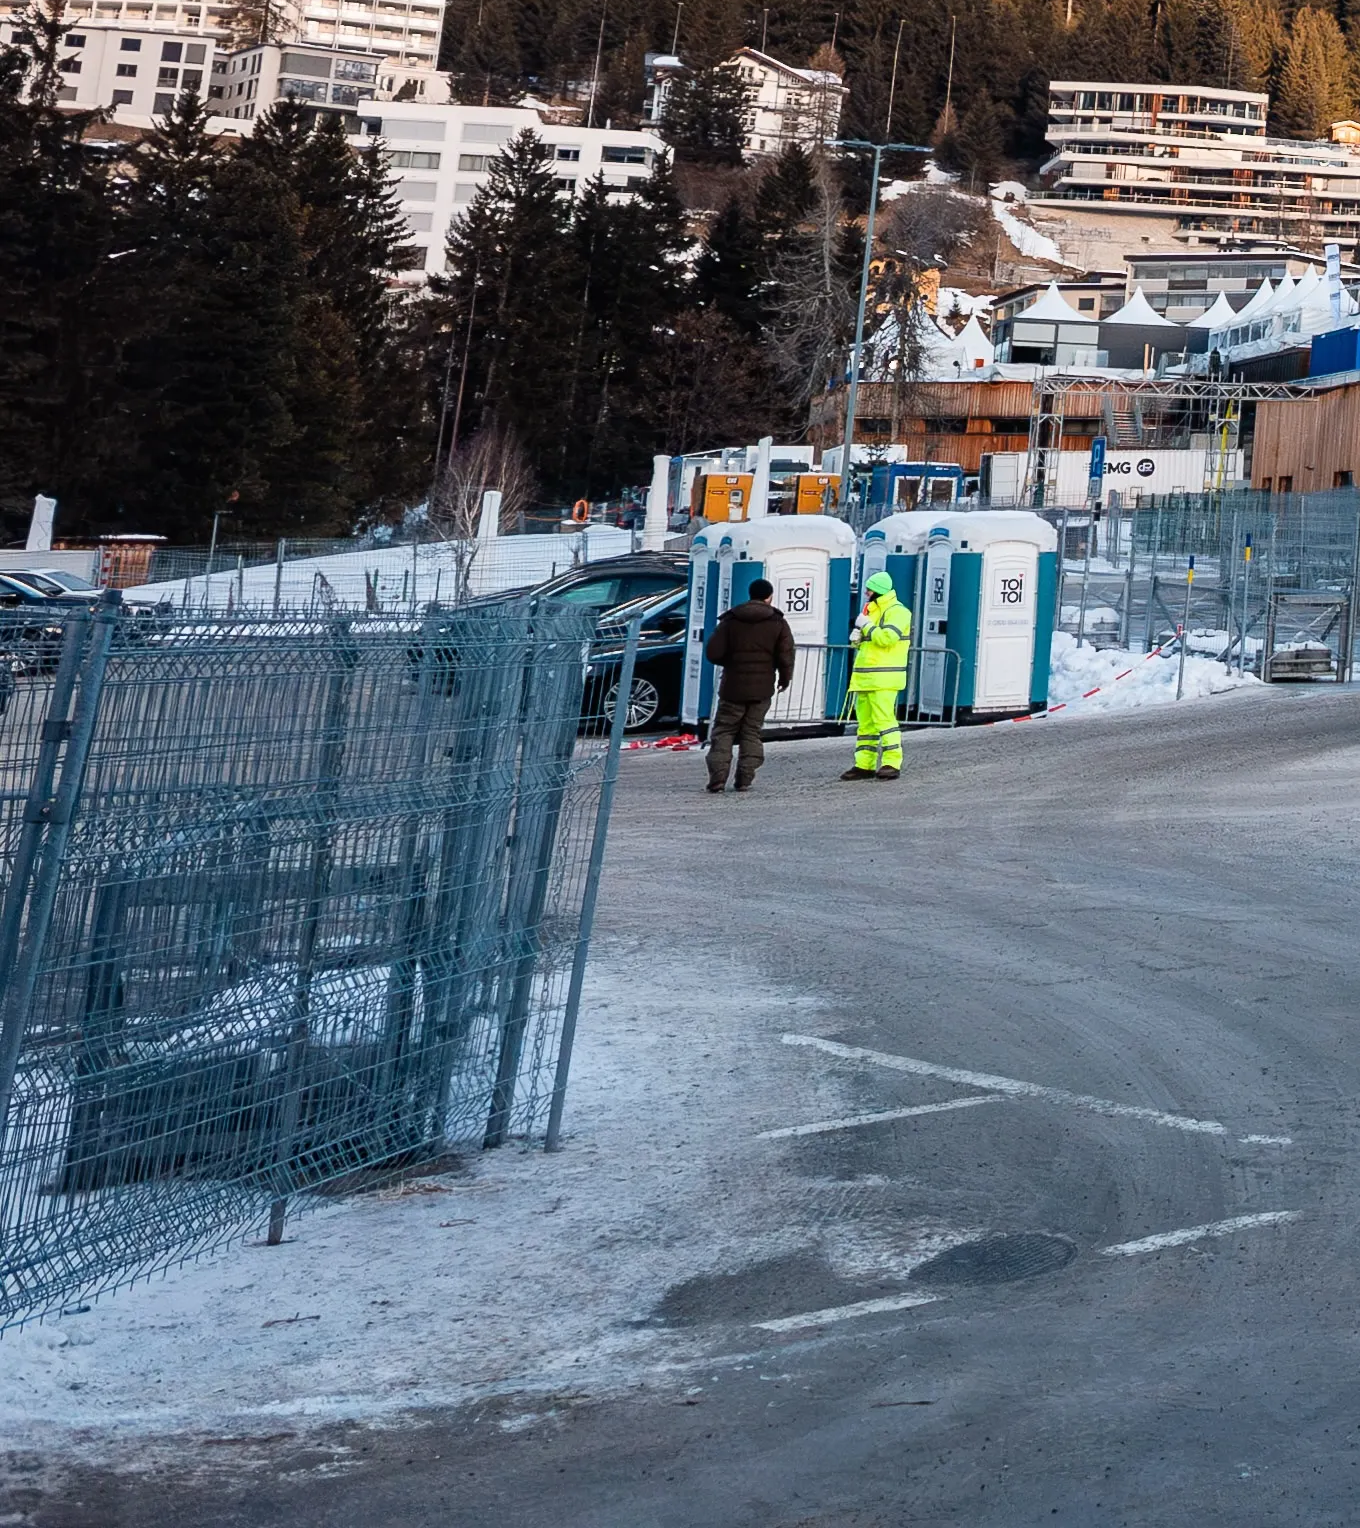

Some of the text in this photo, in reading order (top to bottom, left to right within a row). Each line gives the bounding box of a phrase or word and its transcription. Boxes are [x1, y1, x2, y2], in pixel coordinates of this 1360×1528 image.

[1001, 573, 1024, 591] TOI
[786, 582, 811, 600] TOI
[1000, 590, 1022, 603] TOI
[786, 600, 809, 612] TOI
